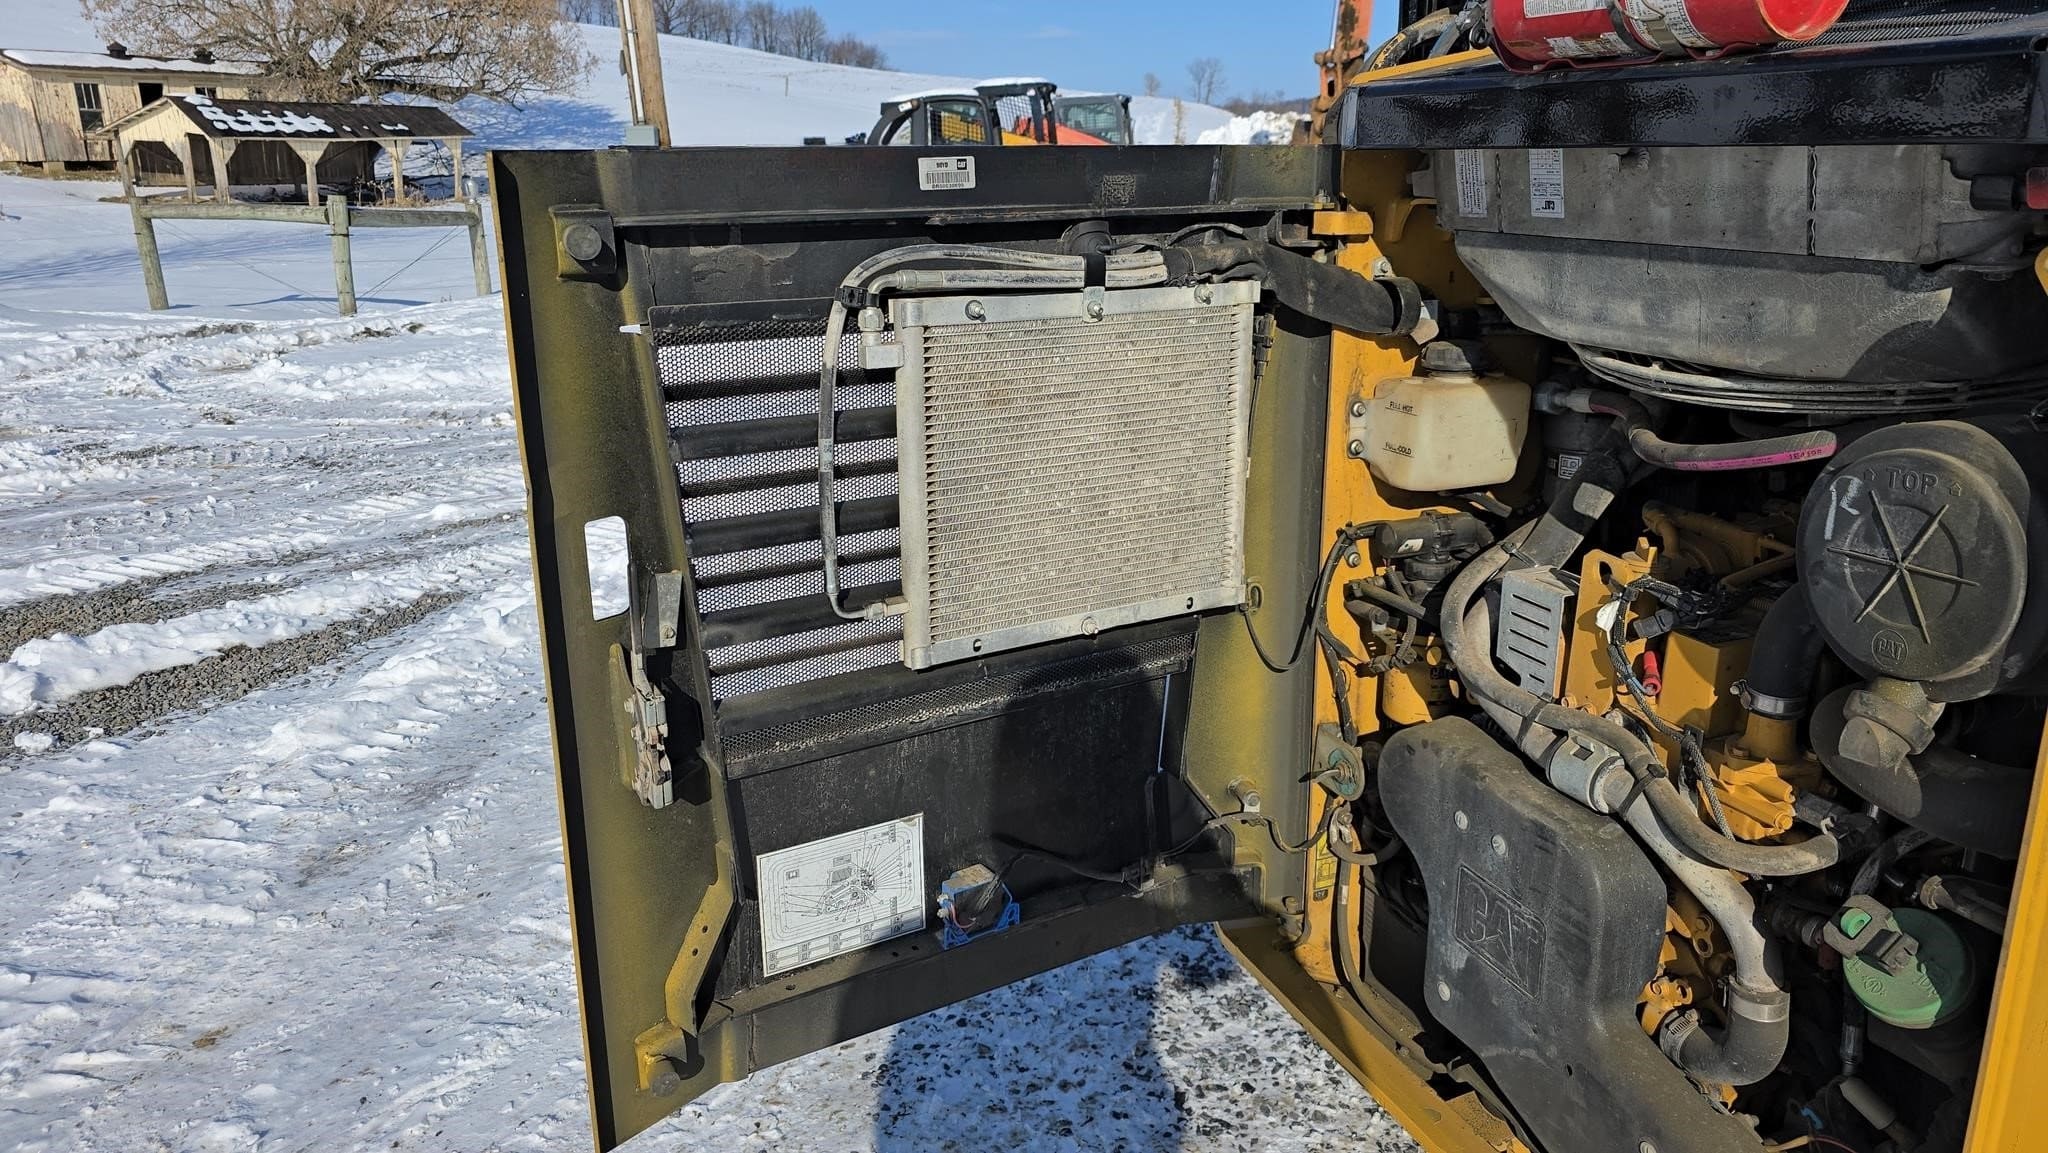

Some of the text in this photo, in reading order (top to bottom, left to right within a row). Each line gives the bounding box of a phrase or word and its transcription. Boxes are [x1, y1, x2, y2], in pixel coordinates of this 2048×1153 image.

[1390, 401, 1401, 410] FULL
[1397, 445, 1412, 455] COLD
[1886, 465, 1939, 495] TOP
[1875, 637, 1904, 660] CAT
[1462, 881, 1539, 989] CAT
